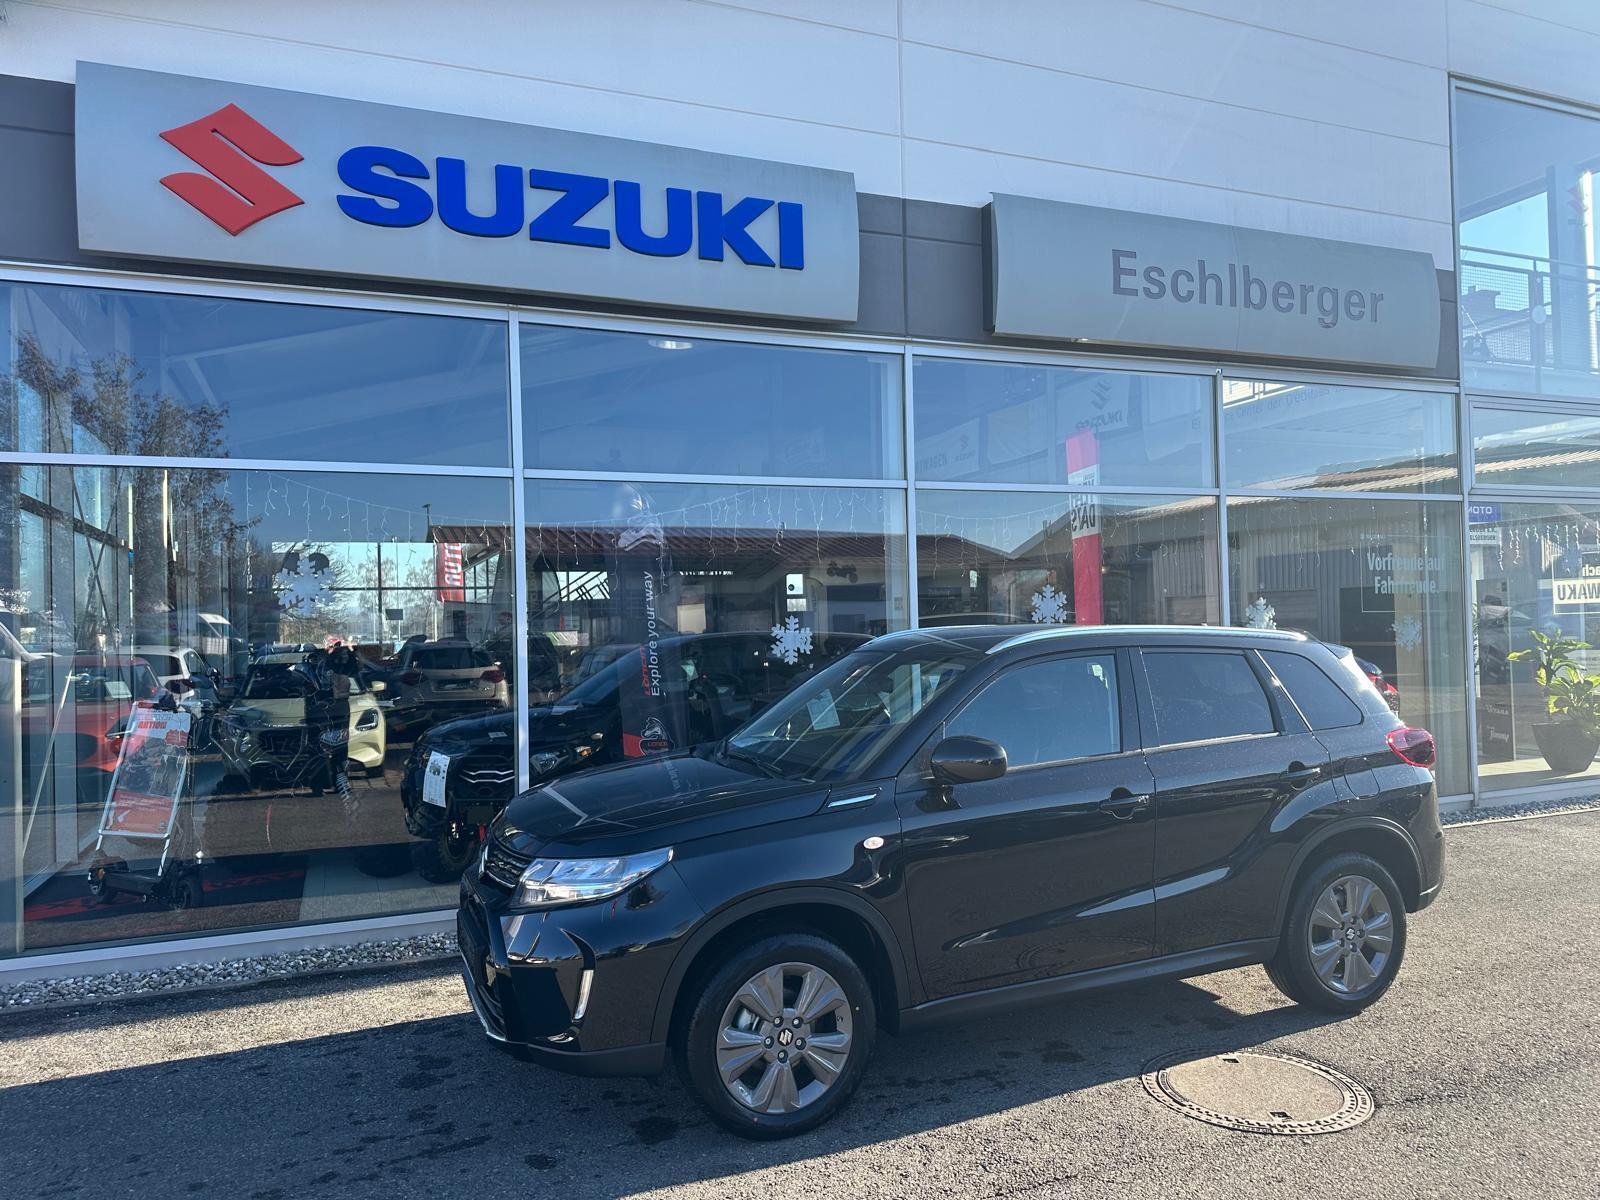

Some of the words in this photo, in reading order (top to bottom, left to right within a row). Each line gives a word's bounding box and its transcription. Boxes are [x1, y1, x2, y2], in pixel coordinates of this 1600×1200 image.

[337, 145, 805, 271] SUZUKI
[1111, 248, 1384, 329] Eschlberger
[642, 571, 654, 602] way
[646, 605, 660, 638] your
[647, 641, 662, 696] Explore
